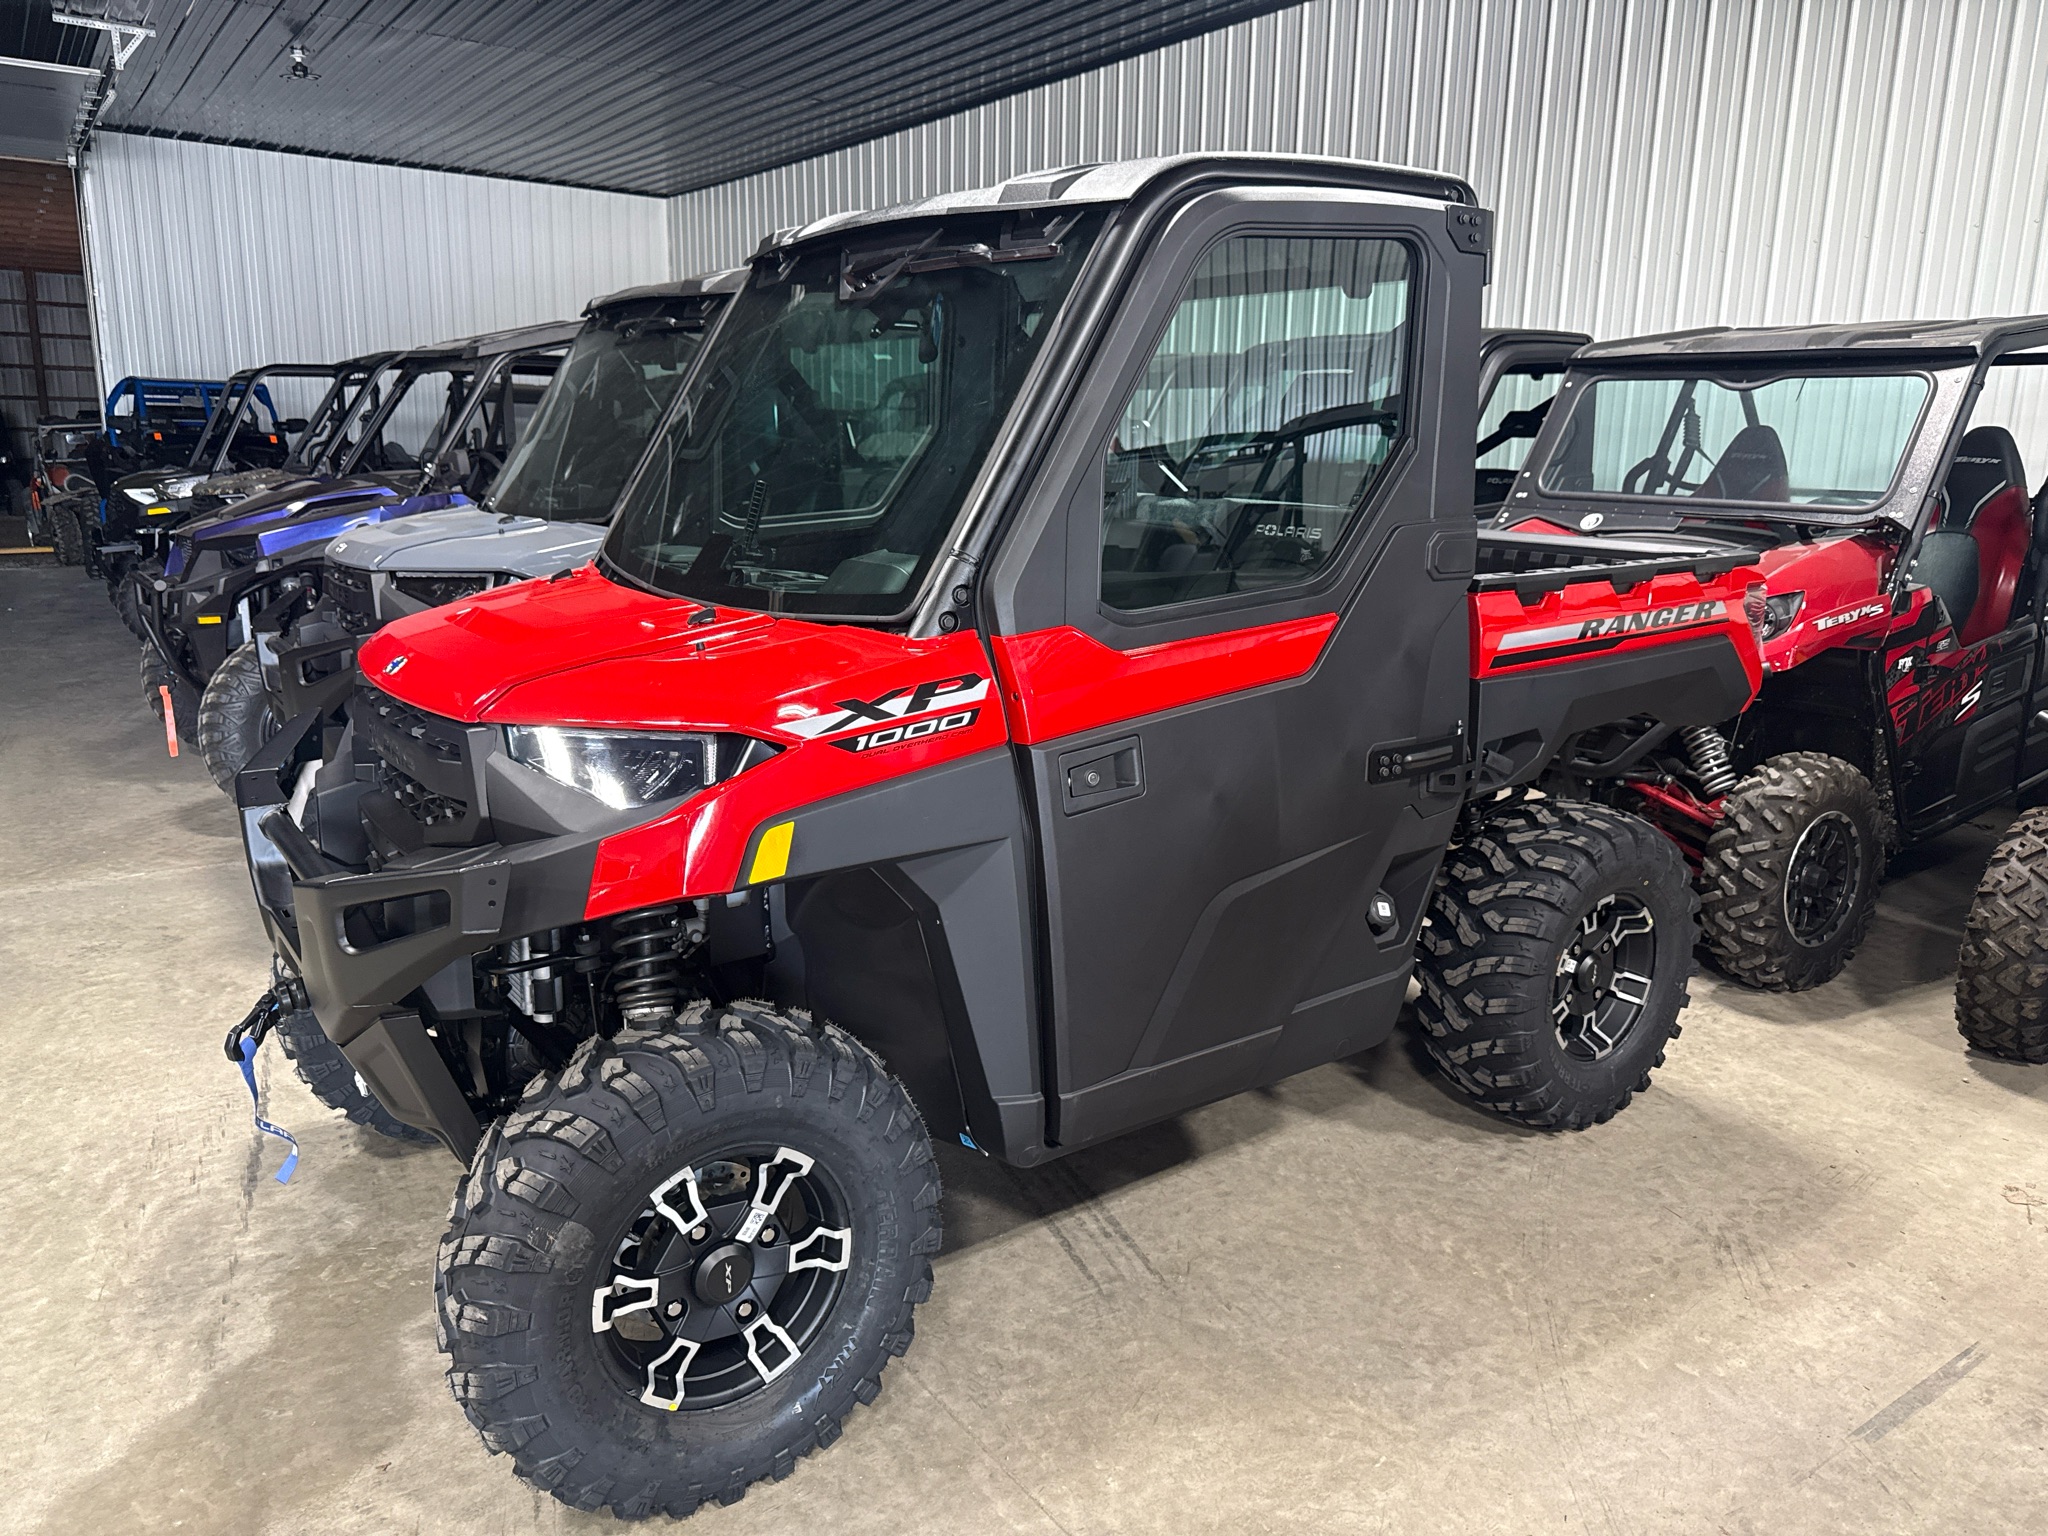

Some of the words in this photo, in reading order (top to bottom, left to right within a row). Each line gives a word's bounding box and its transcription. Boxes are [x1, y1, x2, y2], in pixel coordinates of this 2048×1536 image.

[1255, 524, 1322, 539] POLARIS
[1577, 600, 1717, 640] RANGER
[816, 672, 983, 736] XP
[856, 711, 972, 752] 1000
[861, 748, 890, 760] DUAL
[893, 734, 949, 751] OVERHEAD
[950, 728, 973, 738] CAM
[725, 1263, 732, 1294] XP
